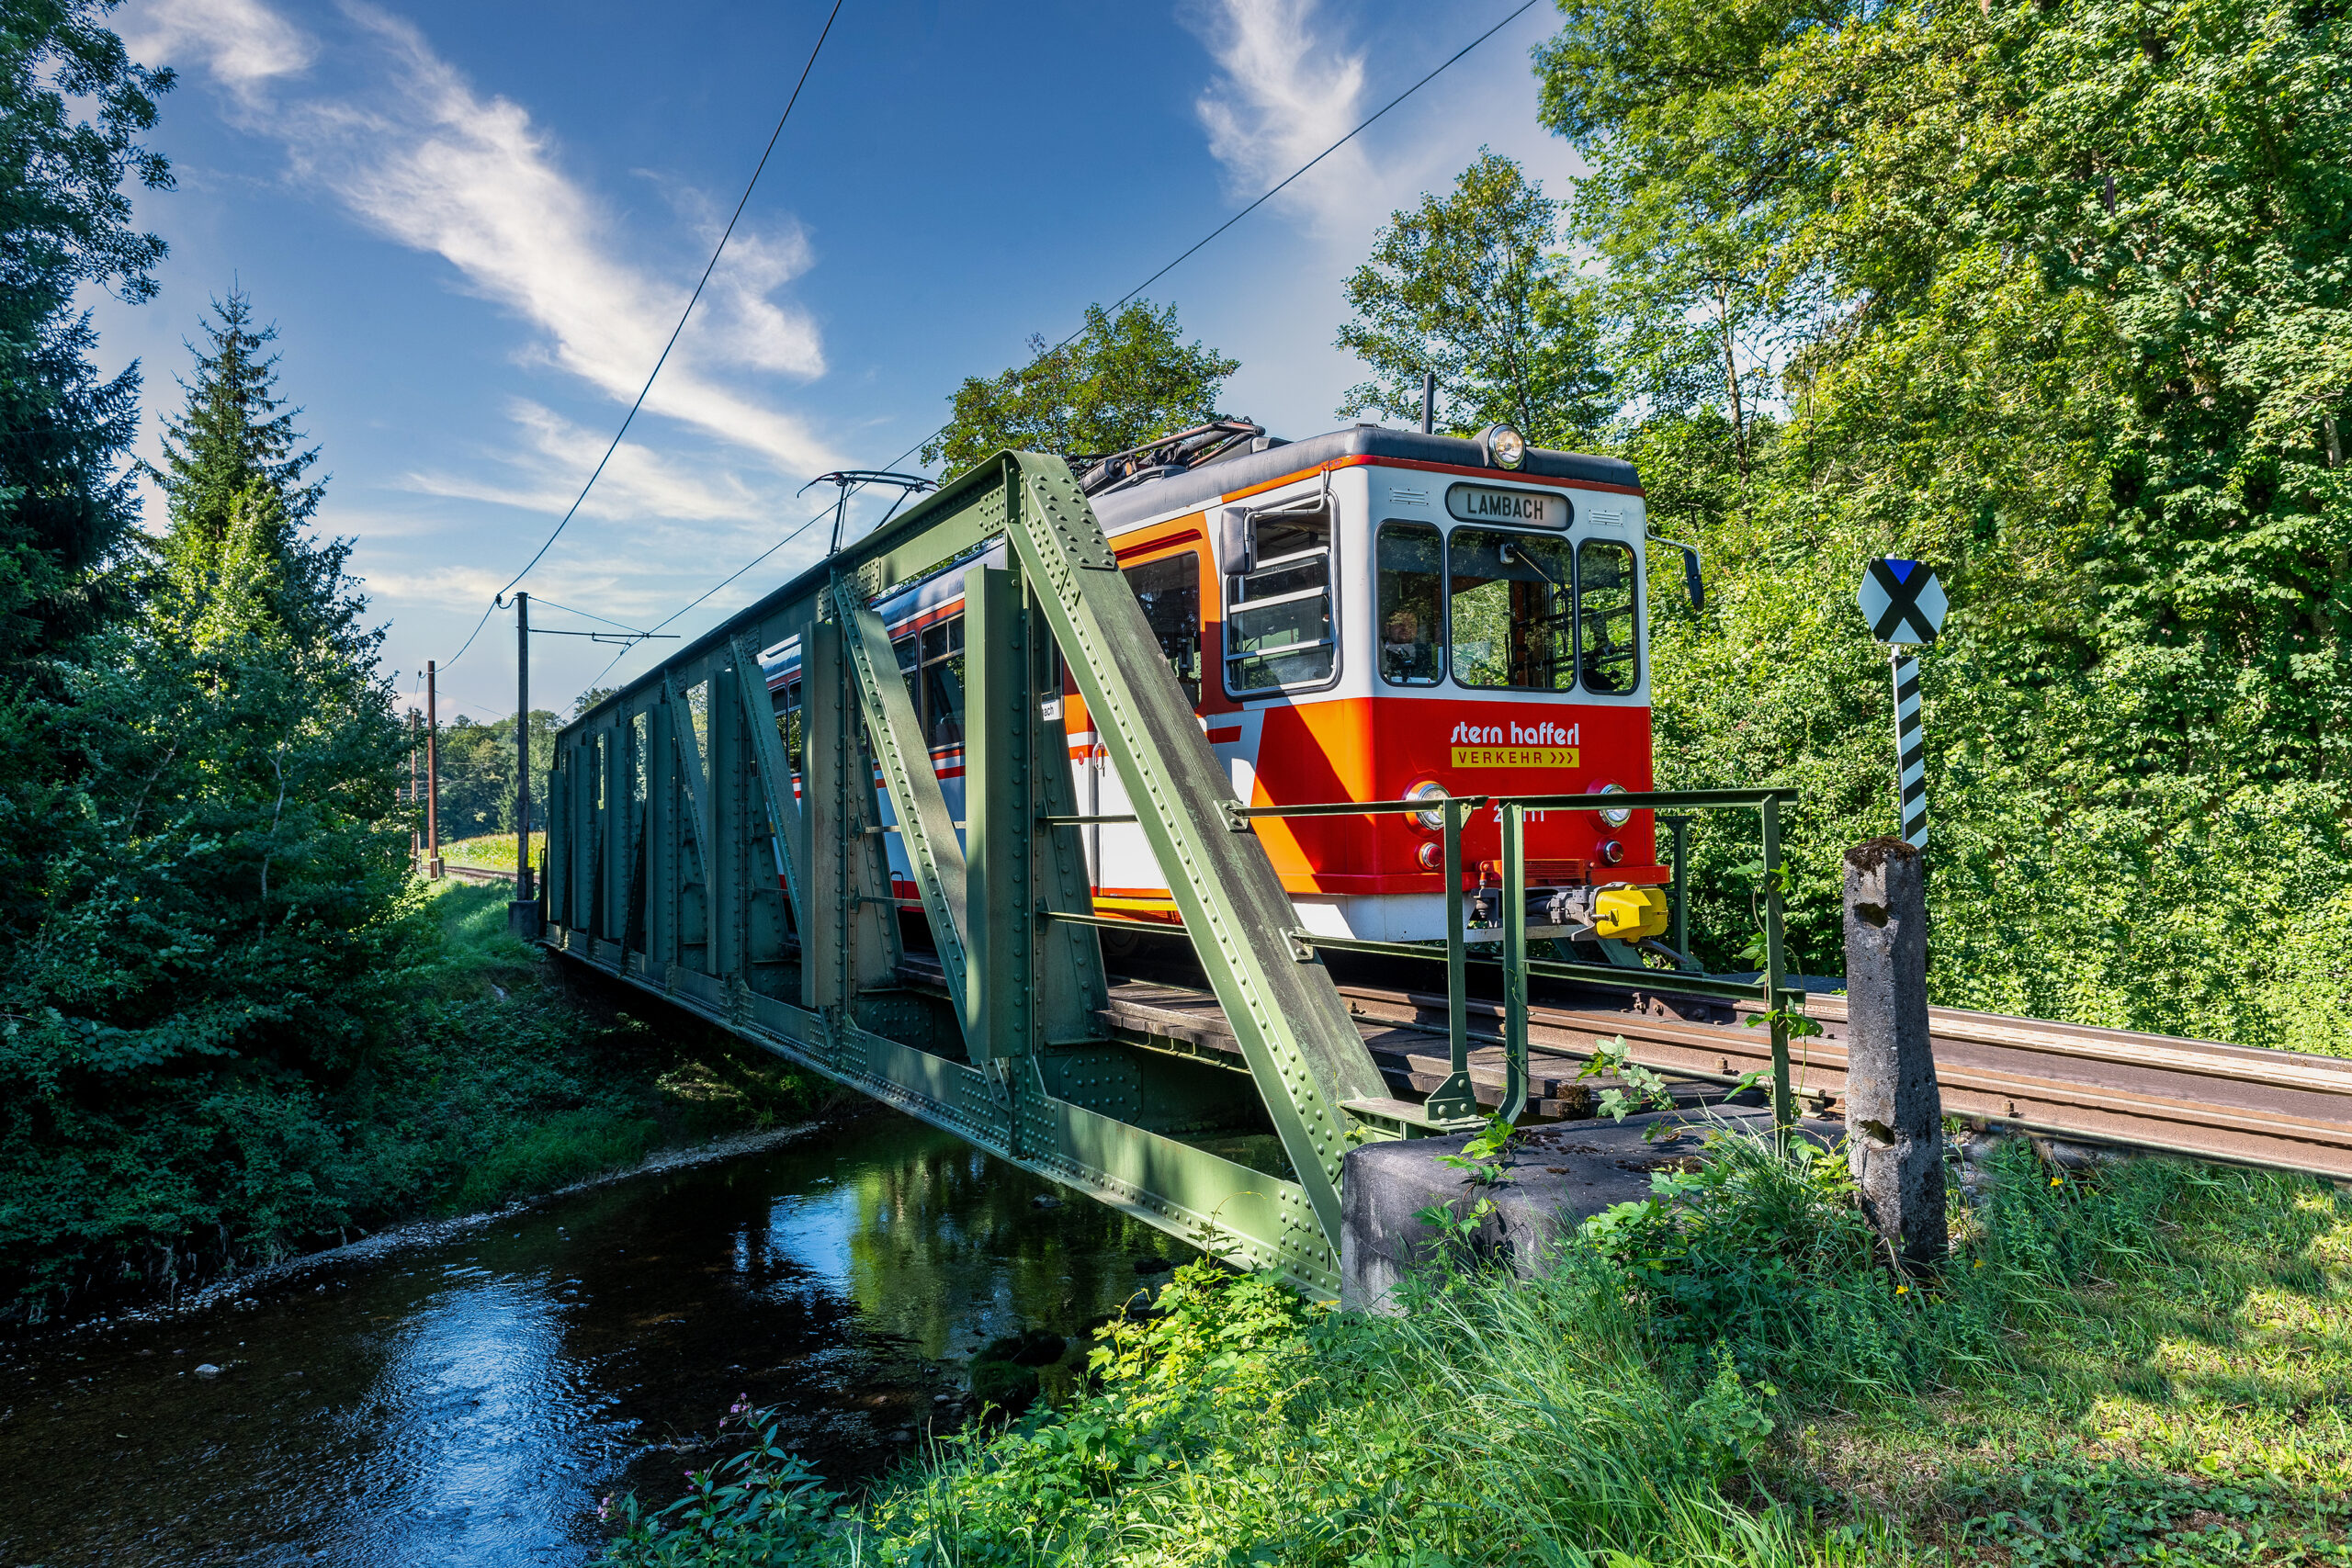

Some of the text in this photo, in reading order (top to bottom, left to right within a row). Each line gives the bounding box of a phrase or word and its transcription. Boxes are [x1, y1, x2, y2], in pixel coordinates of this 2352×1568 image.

[1467, 493, 1544, 520] LAMBACH
[1451, 721, 1579, 746] stern hafferl
[1458, 751, 1543, 764] VERKEHR
